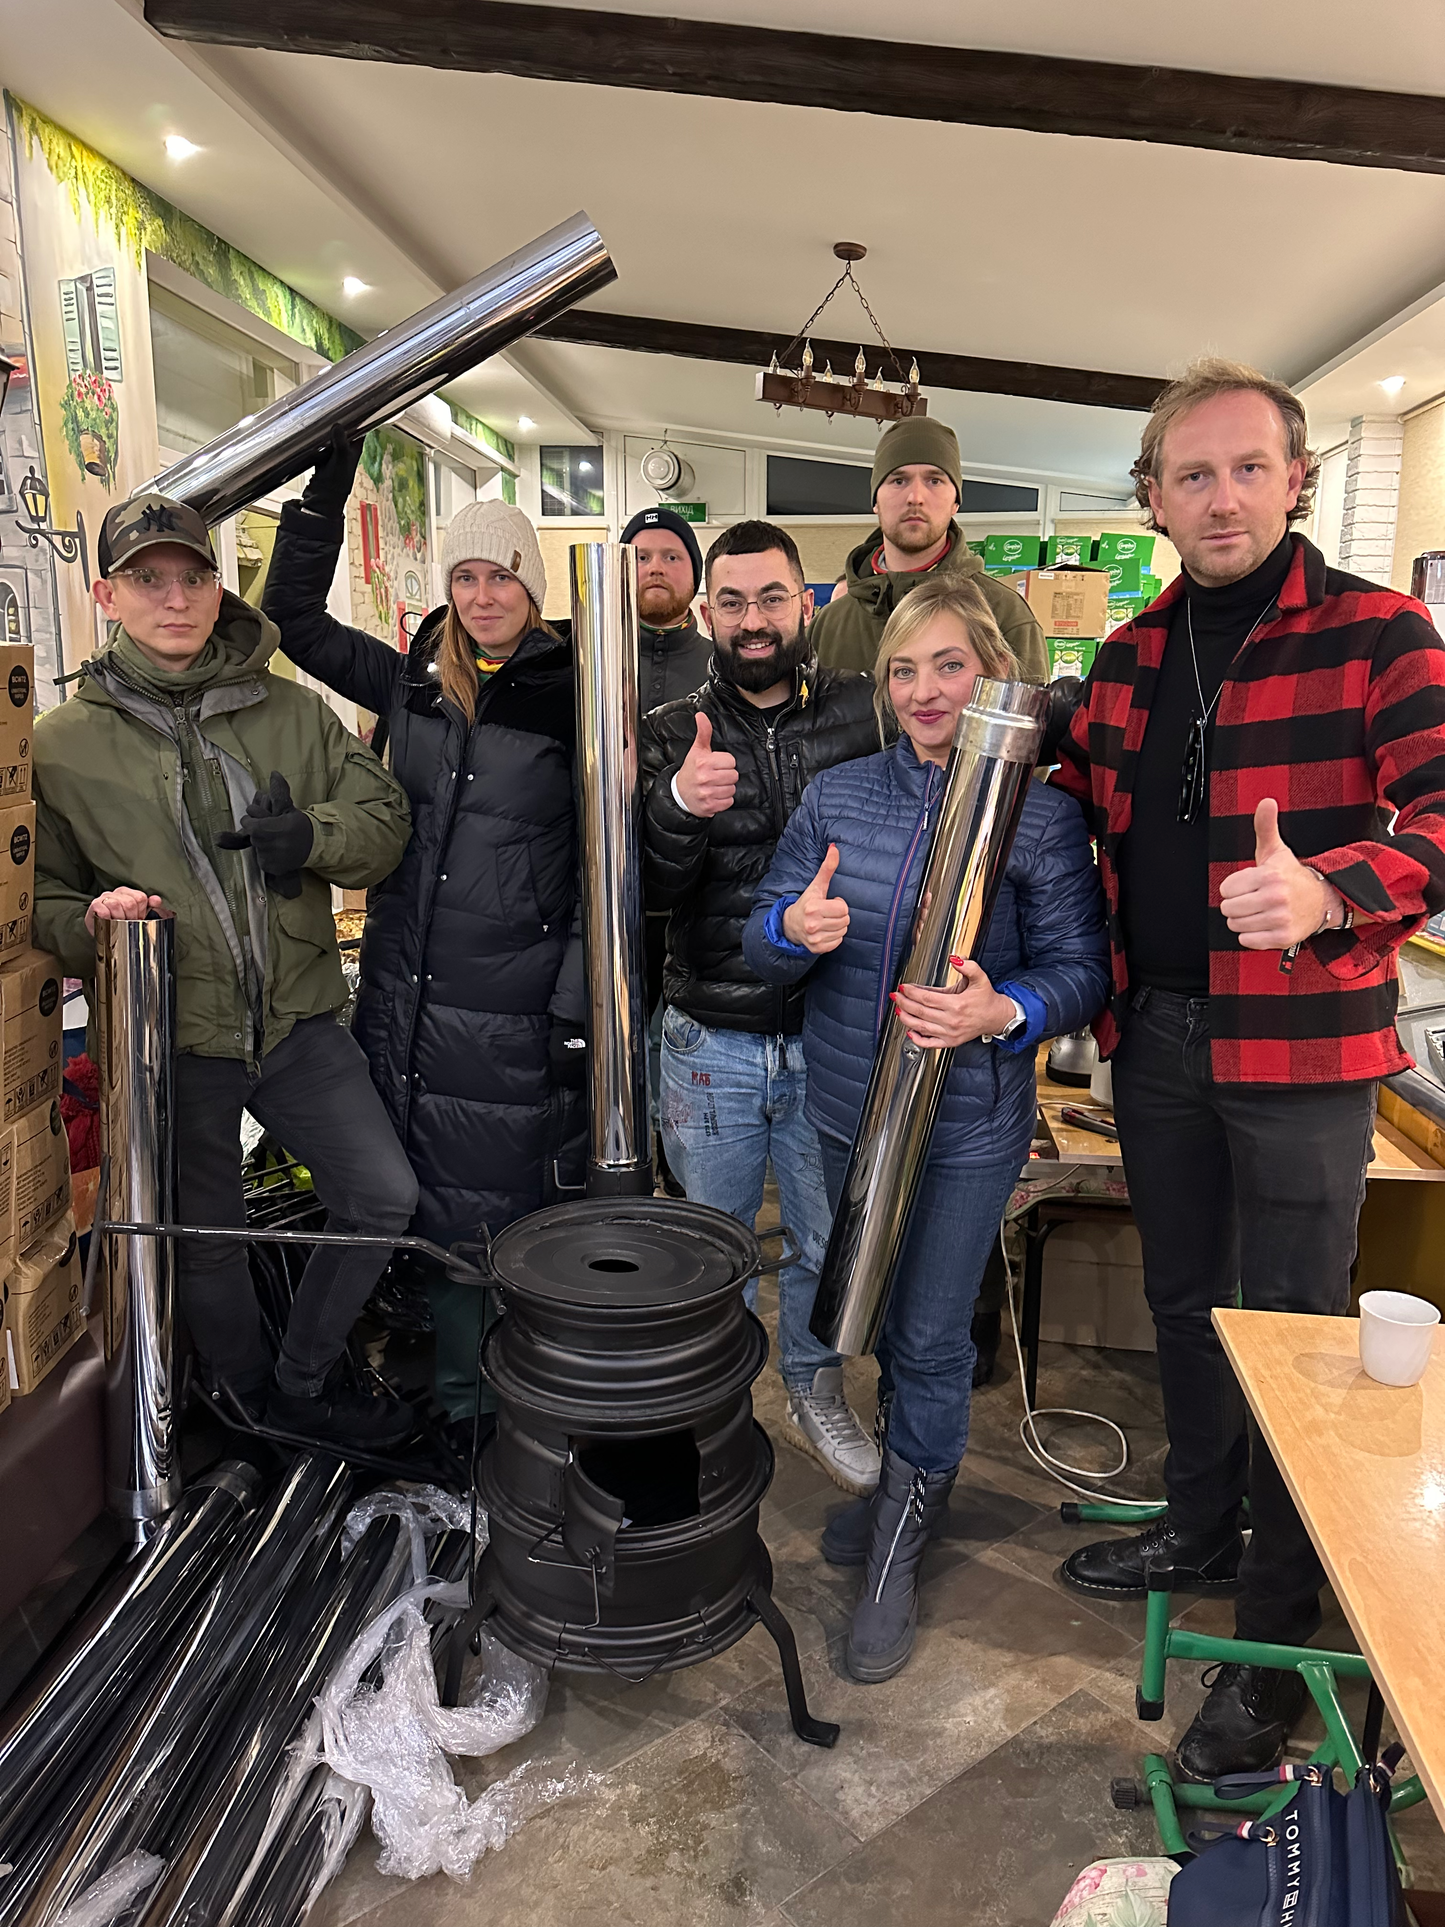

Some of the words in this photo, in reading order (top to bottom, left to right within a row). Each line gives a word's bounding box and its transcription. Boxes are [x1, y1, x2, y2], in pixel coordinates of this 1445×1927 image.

[141, 503, 176, 532] NY
[670, 505, 694, 515] ВИХІД
[1285, 1809, 1301, 1887] TOMMY
